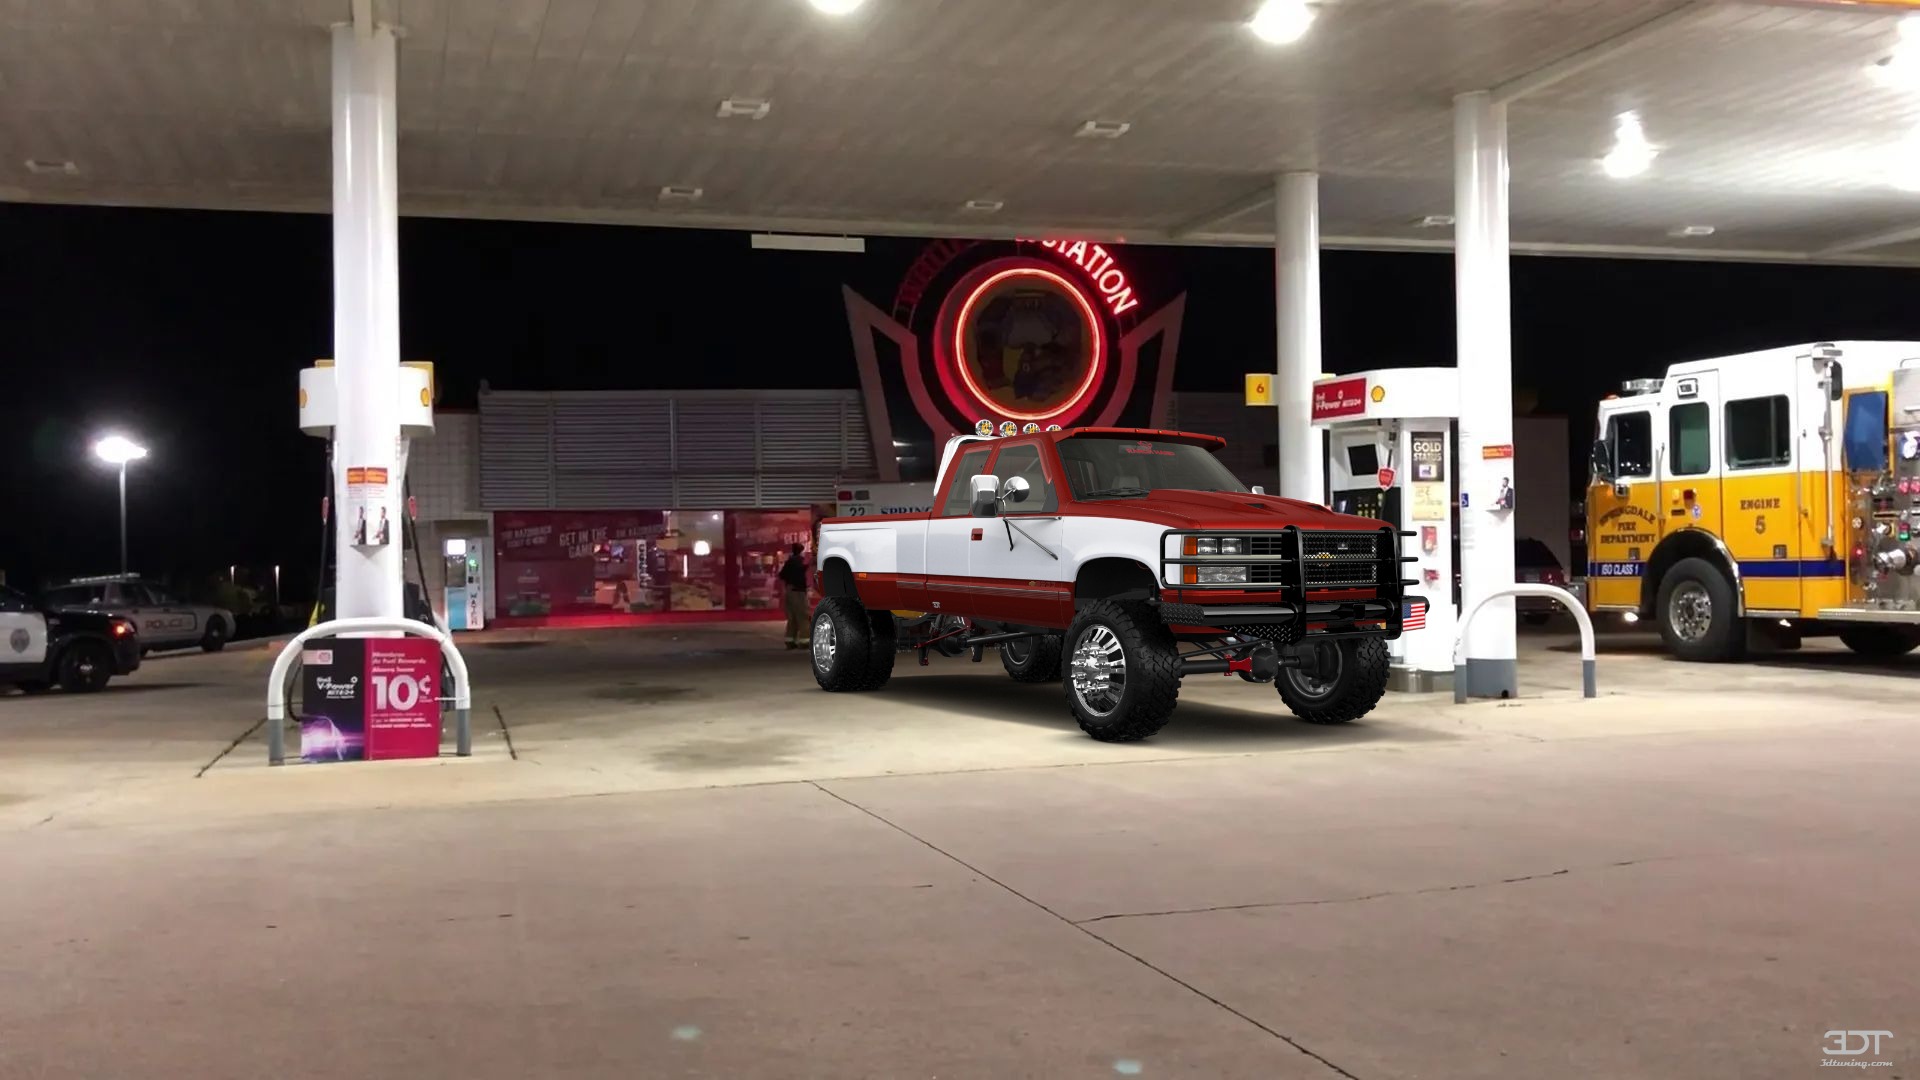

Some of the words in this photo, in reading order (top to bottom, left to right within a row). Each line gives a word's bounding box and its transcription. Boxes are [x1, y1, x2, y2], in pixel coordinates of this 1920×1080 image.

[1256, 383, 1264, 394] 6
[1413, 442, 1442, 452] GOLD
[1413, 453, 1442, 461] STATUS
[1740, 498, 1780, 510] ENGINE
[1599, 505, 1656, 526] SPRINGDALE
[1618, 522, 1636, 531] FIRE
[1755, 514, 1766, 534] 5
[559, 531, 578, 547] GET
[580, 530, 592, 544] IN
[592, 526, 608, 541] THE
[1601, 534, 1656, 543] DEPARTMENT
[1601, 564, 1612, 575] ISO
[1613, 564, 1634, 575] CLASS
[1634, 564, 1639, 575] 1
[145, 619, 183, 629] POLICE
[317, 682, 354, 690] V-Power
[371, 674, 431, 711] 10¢
